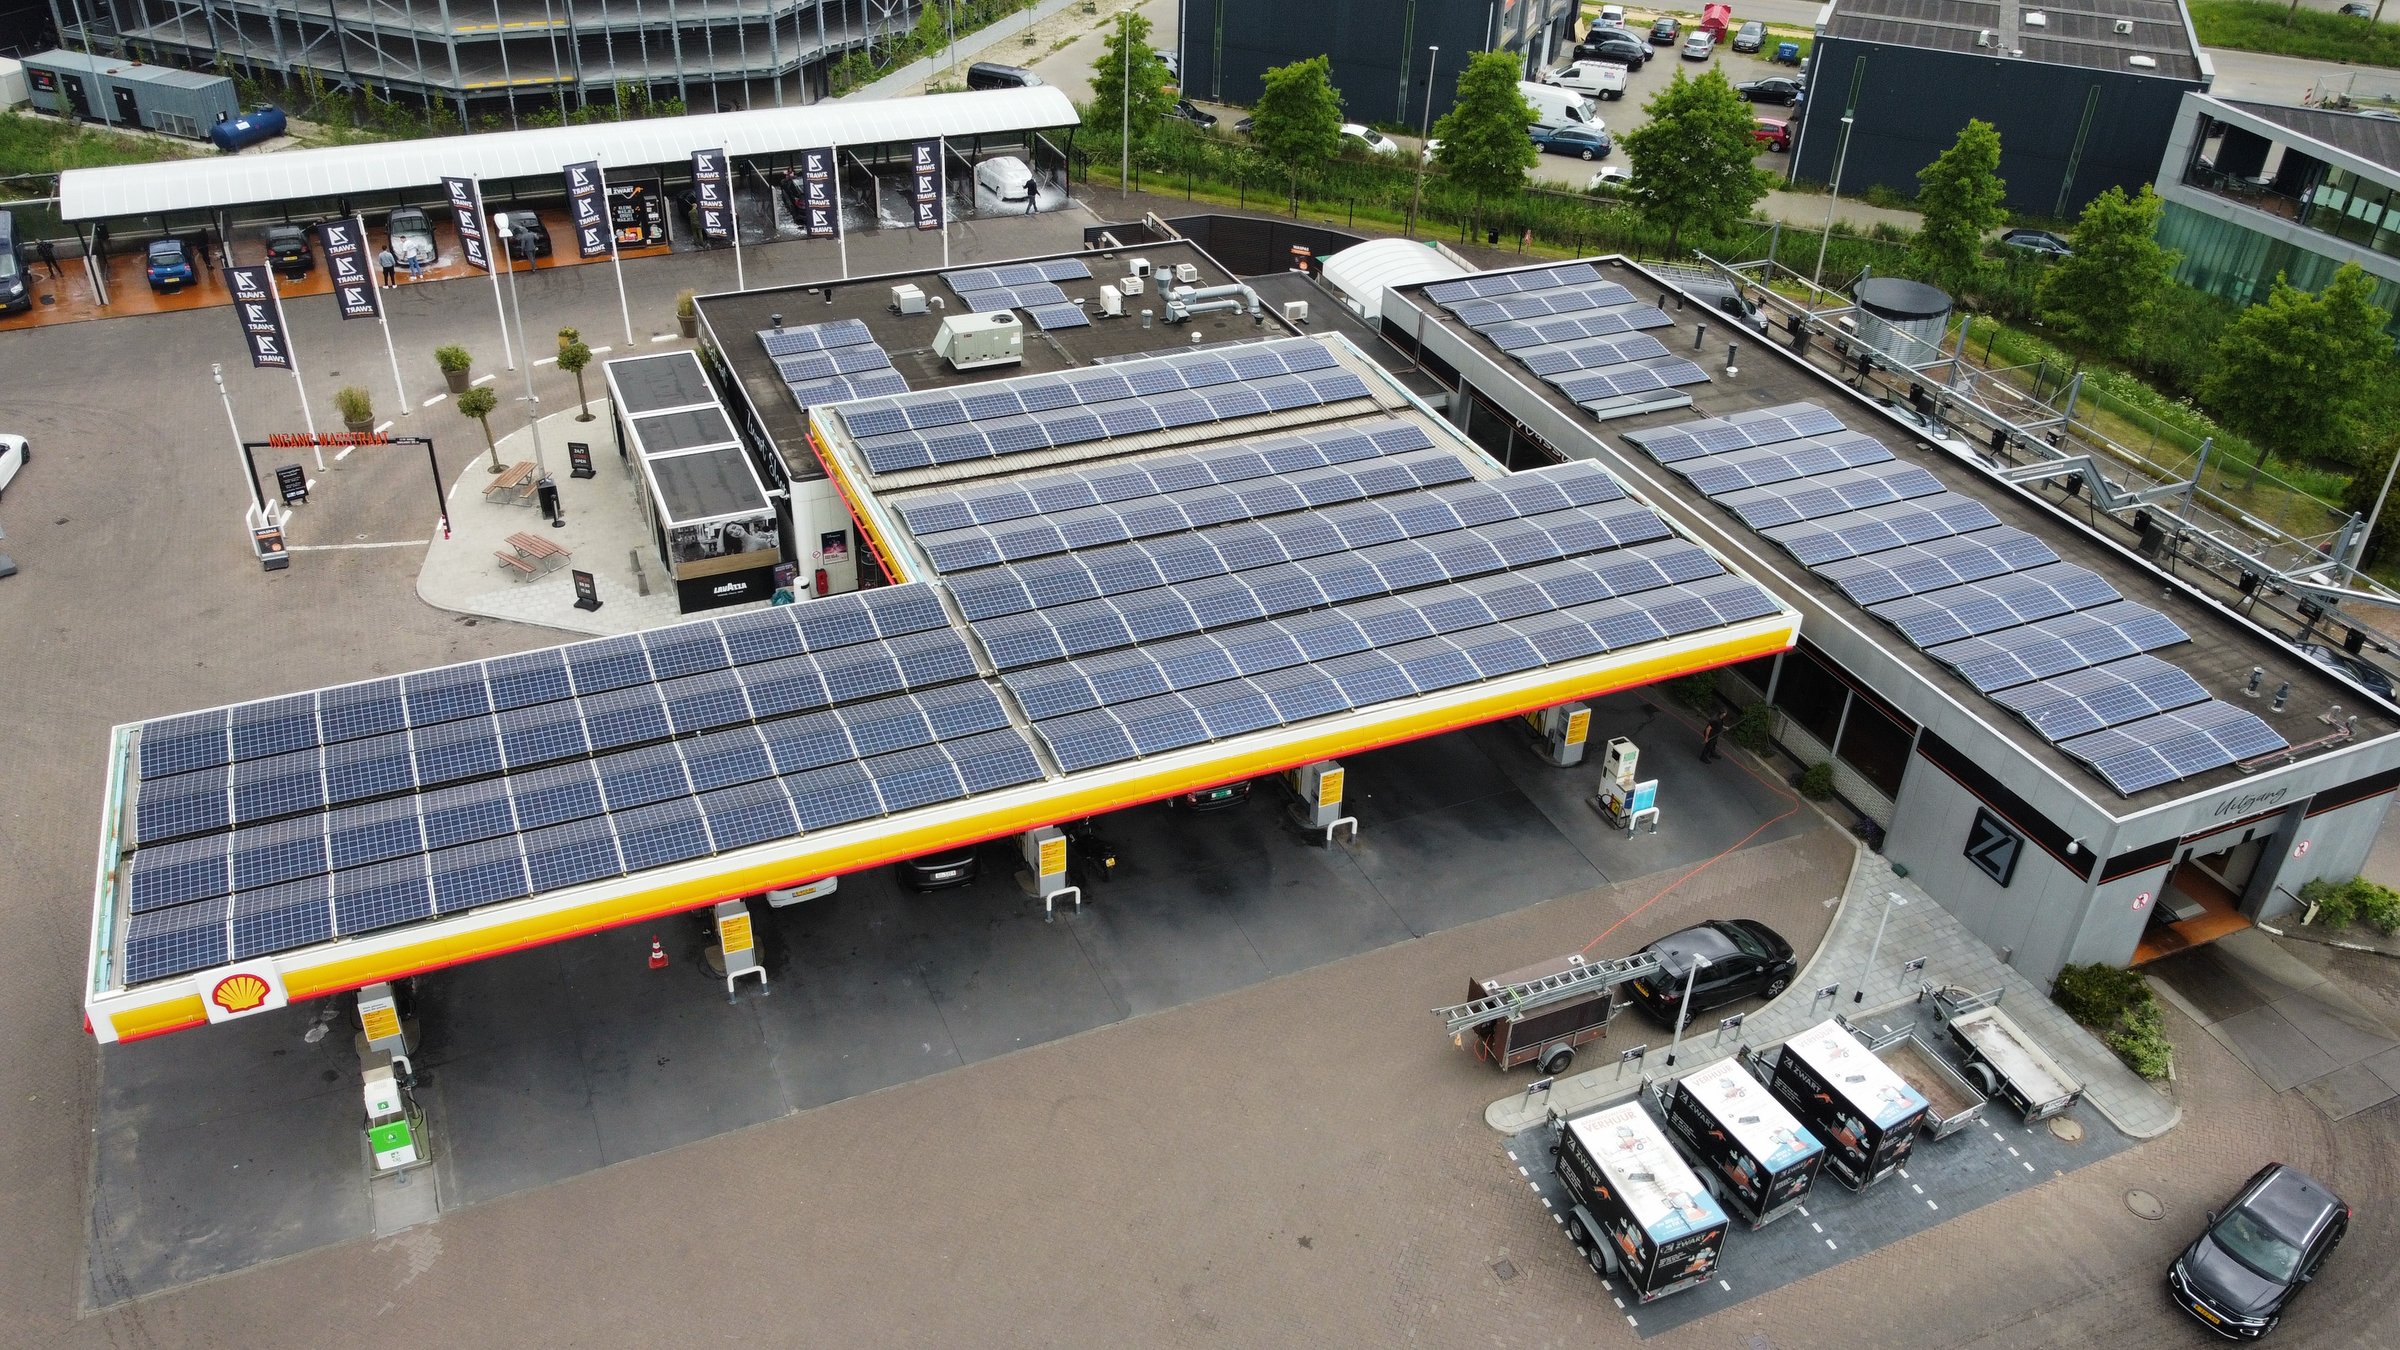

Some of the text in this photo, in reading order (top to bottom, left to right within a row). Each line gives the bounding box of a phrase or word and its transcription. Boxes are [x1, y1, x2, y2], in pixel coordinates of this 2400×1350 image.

[269, 432, 315, 448] INGANG
[318, 431, 389, 447] WASSTRAAT
[714, 582, 747, 594] LAVAZZA
[2214, 787, 2287, 816] Uitgang
[1692, 1065, 1734, 1087] VERHUUR
[1793, 1066, 1821, 1093] ZWART
[1583, 1111, 1637, 1133] VERHUUR
[1689, 1102, 1715, 1129] ZWART
[1576, 1149, 1601, 1185] ZWART
